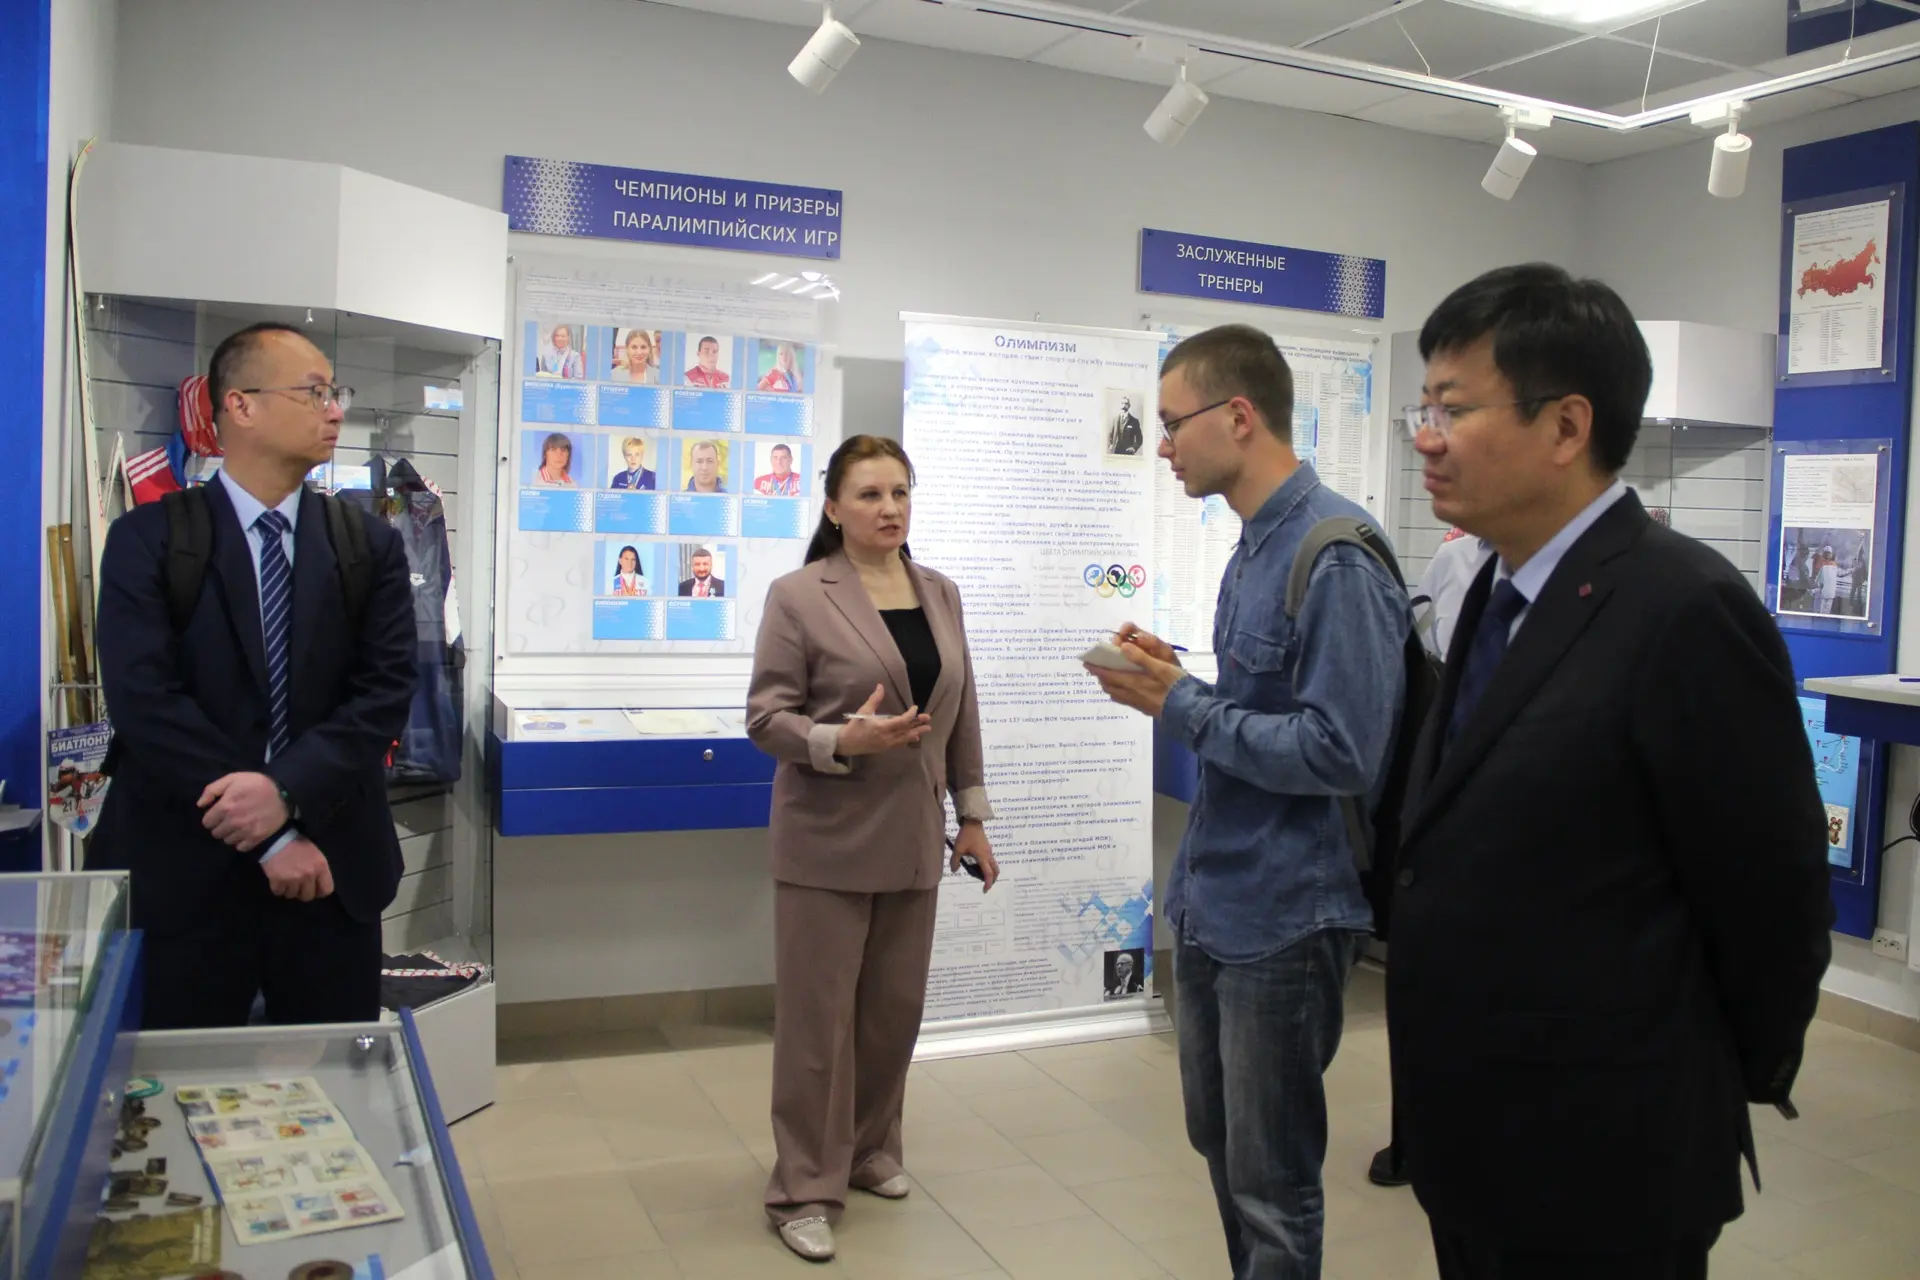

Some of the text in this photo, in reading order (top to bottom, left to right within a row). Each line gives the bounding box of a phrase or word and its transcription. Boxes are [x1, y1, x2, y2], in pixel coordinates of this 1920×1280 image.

[615, 179, 840, 217] ЧЕМПИОНЫ И ПРИЗЕРЫ
[613, 210, 838, 247] ПАРАЛИМПИЙСКИХ ИГР
[1176, 243, 1286, 271] ЗАСЛУЖЕННЫЕ
[1198, 273, 1264, 295] ТРЕНЕРЫ
[51, 734, 110, 753] БИАТЛОНУ
[62, 800, 73, 813] 21
